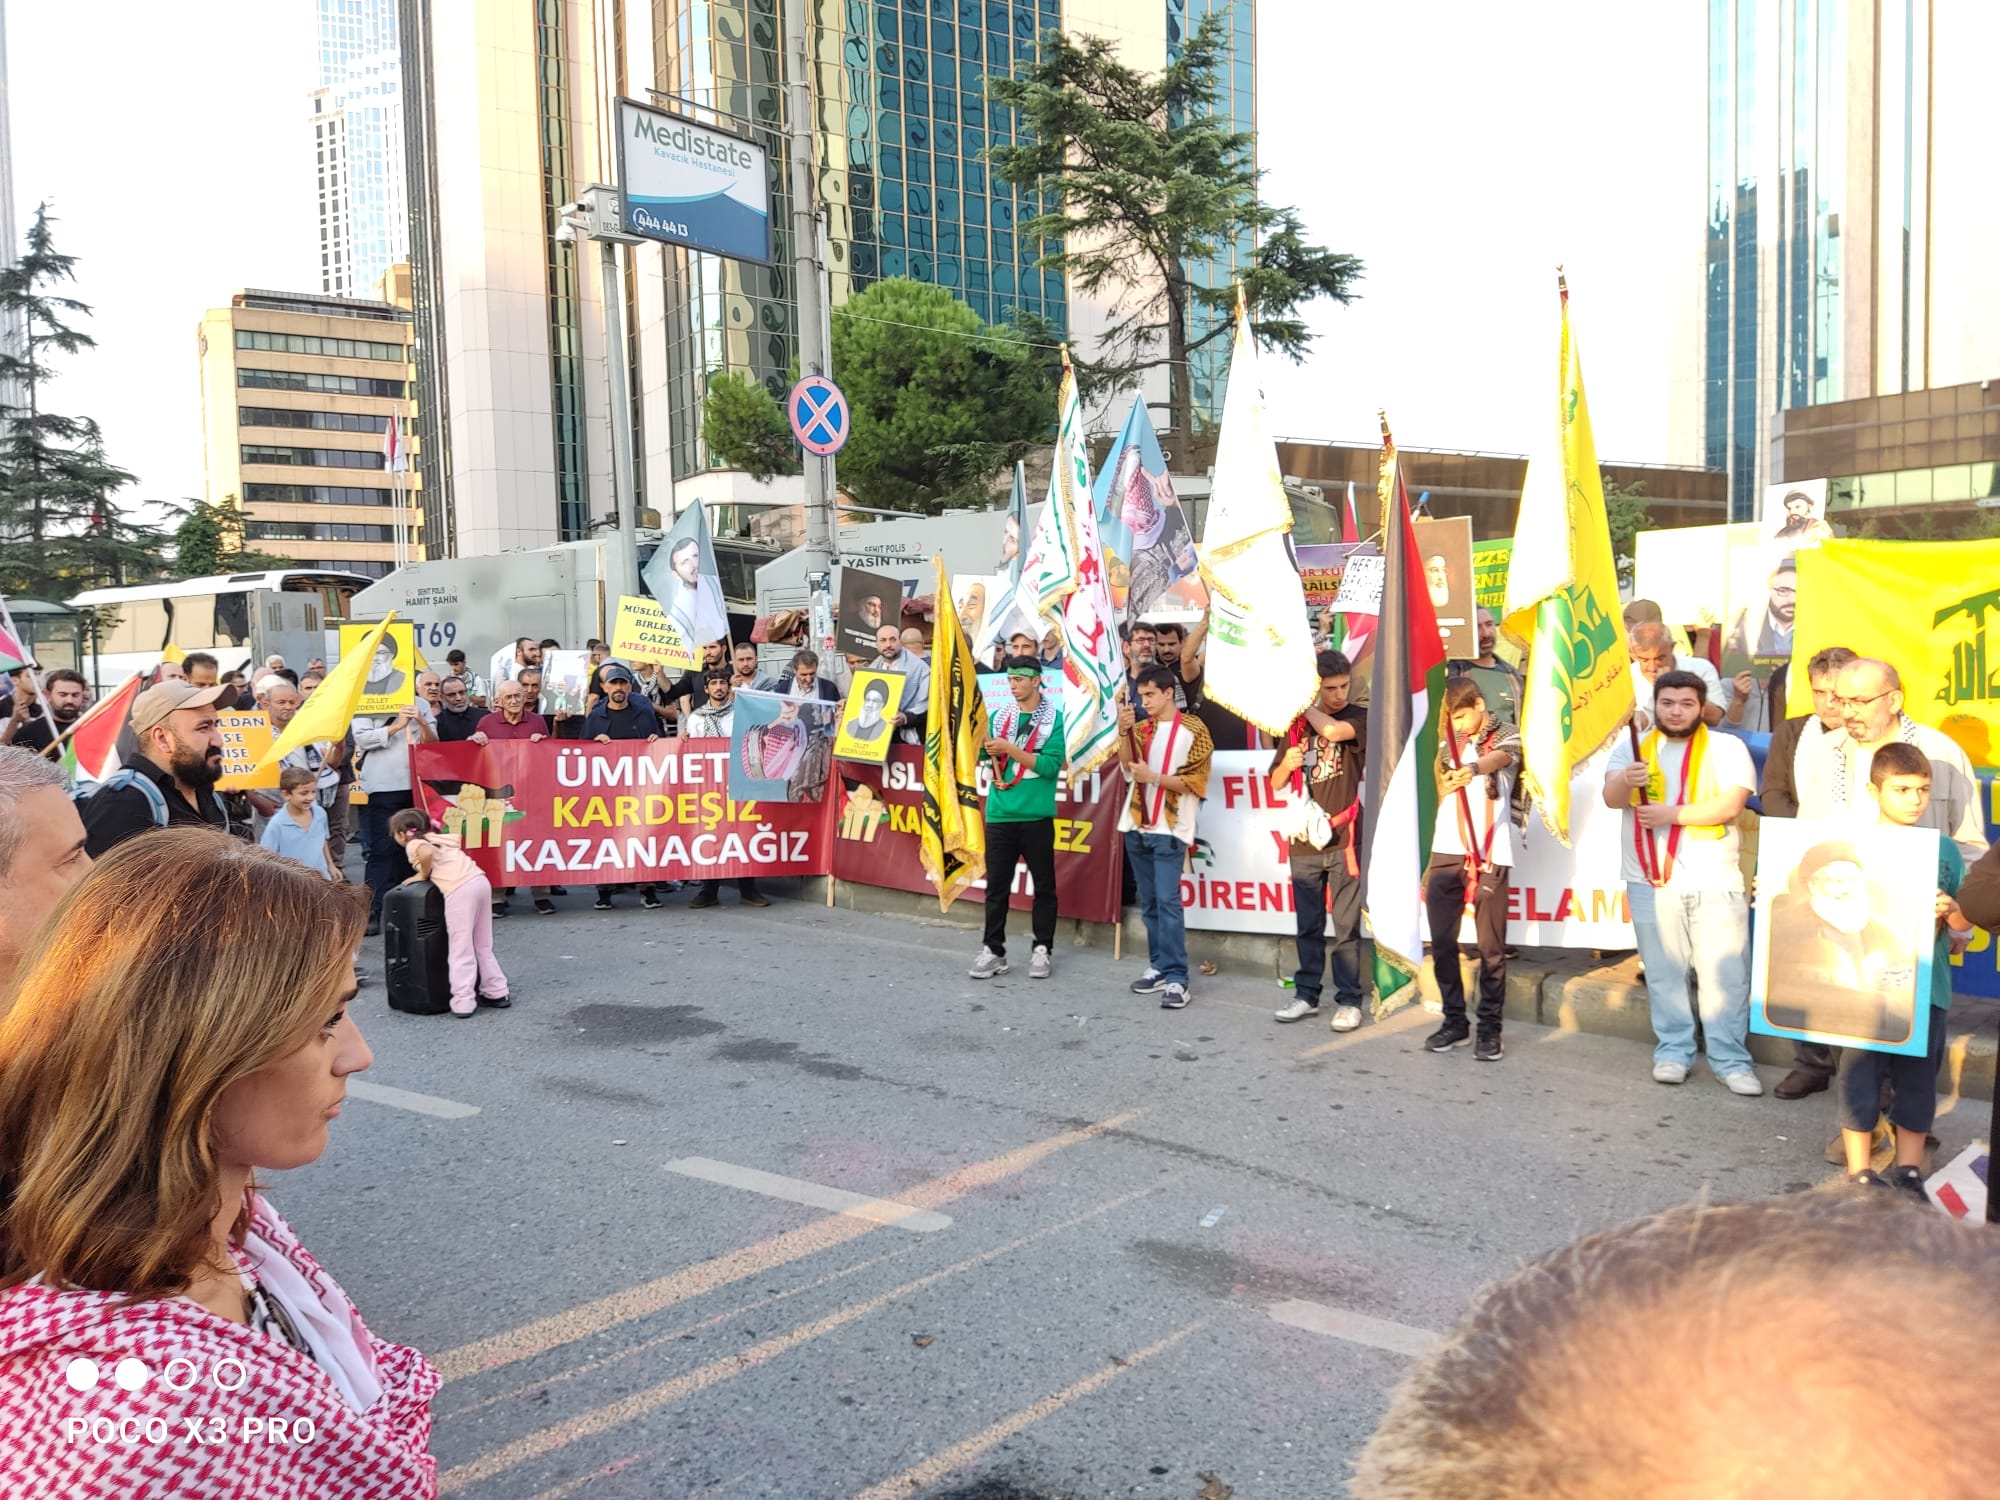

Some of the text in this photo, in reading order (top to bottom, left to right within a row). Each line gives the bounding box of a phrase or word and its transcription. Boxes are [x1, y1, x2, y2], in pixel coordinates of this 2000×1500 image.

[633, 111, 753, 170] Medistate
[691, 156, 736, 178] Hastanesi
[638, 213, 660, 231] 444
[405, 595, 458, 607] HAMİT ŞAHİN
[635, 619, 679, 634] BİRLEŞ
[639, 632, 682, 647] GAZZE
[619, 641, 647, 653] ATEŞ
[556, 748, 730, 787] ÜMMET
[1222, 767, 1289, 809] FİL
[552, 790, 762, 831] KARDEŞİZ
[504, 822, 810, 873] KAZANACAĞIZ
[1179, 872, 1296, 912] DİRENİ
[1506, 887, 1632, 924] ELAM
